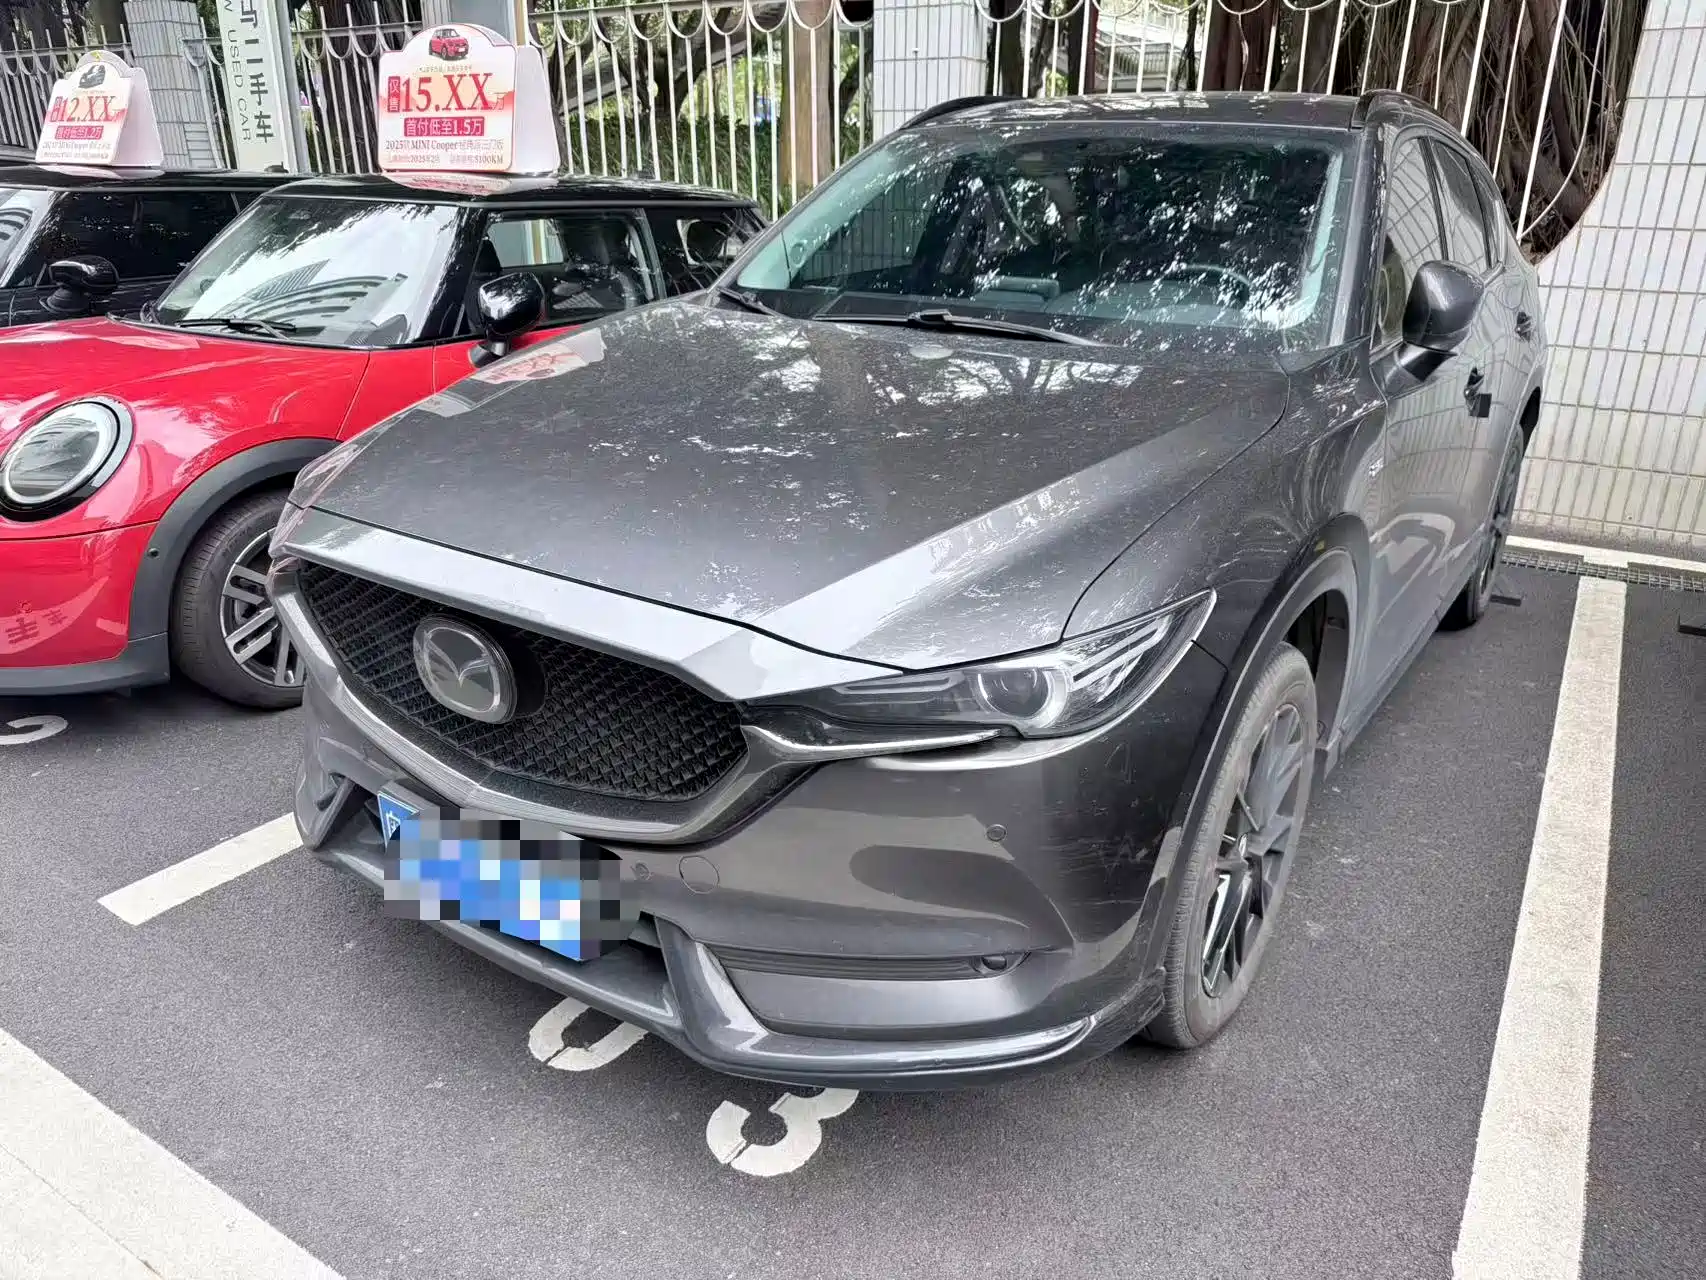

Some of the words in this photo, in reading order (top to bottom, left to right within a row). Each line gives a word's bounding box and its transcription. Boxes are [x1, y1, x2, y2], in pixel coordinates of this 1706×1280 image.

[227, 29, 244, 89] USED
[236, 97, 251, 141] CAR
[406, 118, 483, 135] 首付低至1.5万
[431, 139, 458, 153] Cooper
